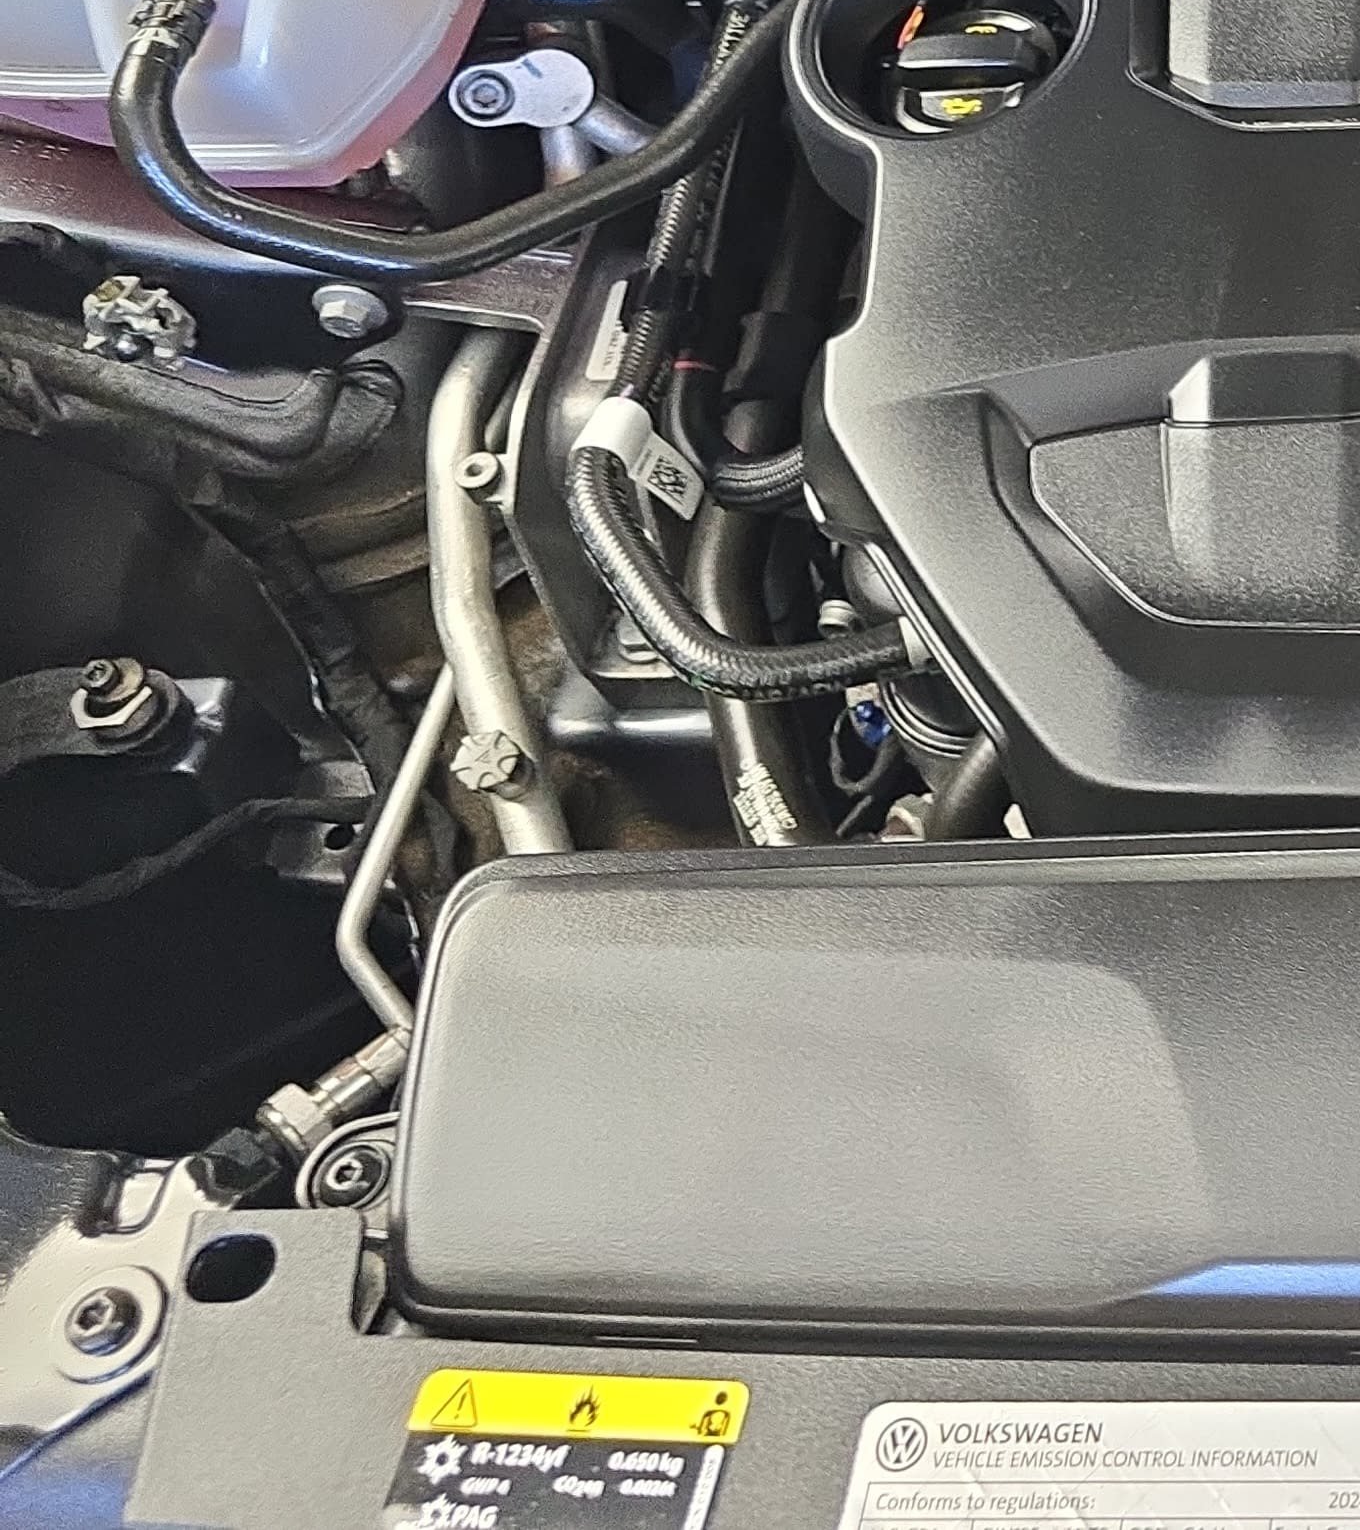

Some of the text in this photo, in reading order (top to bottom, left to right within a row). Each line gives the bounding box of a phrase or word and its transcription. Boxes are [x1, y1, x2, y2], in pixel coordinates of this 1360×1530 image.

[939, 1422, 1103, 1444] VOLKSWAGEN
[471, 1441, 572, 1473] R-1234yf
[933, 1448, 1319, 1469] VEHICLE EMISSION CONTROL INFORMATION
[876, 1491, 1096, 1515] Conforms to regulations:
[451, 1505, 500, 1529] PAG
